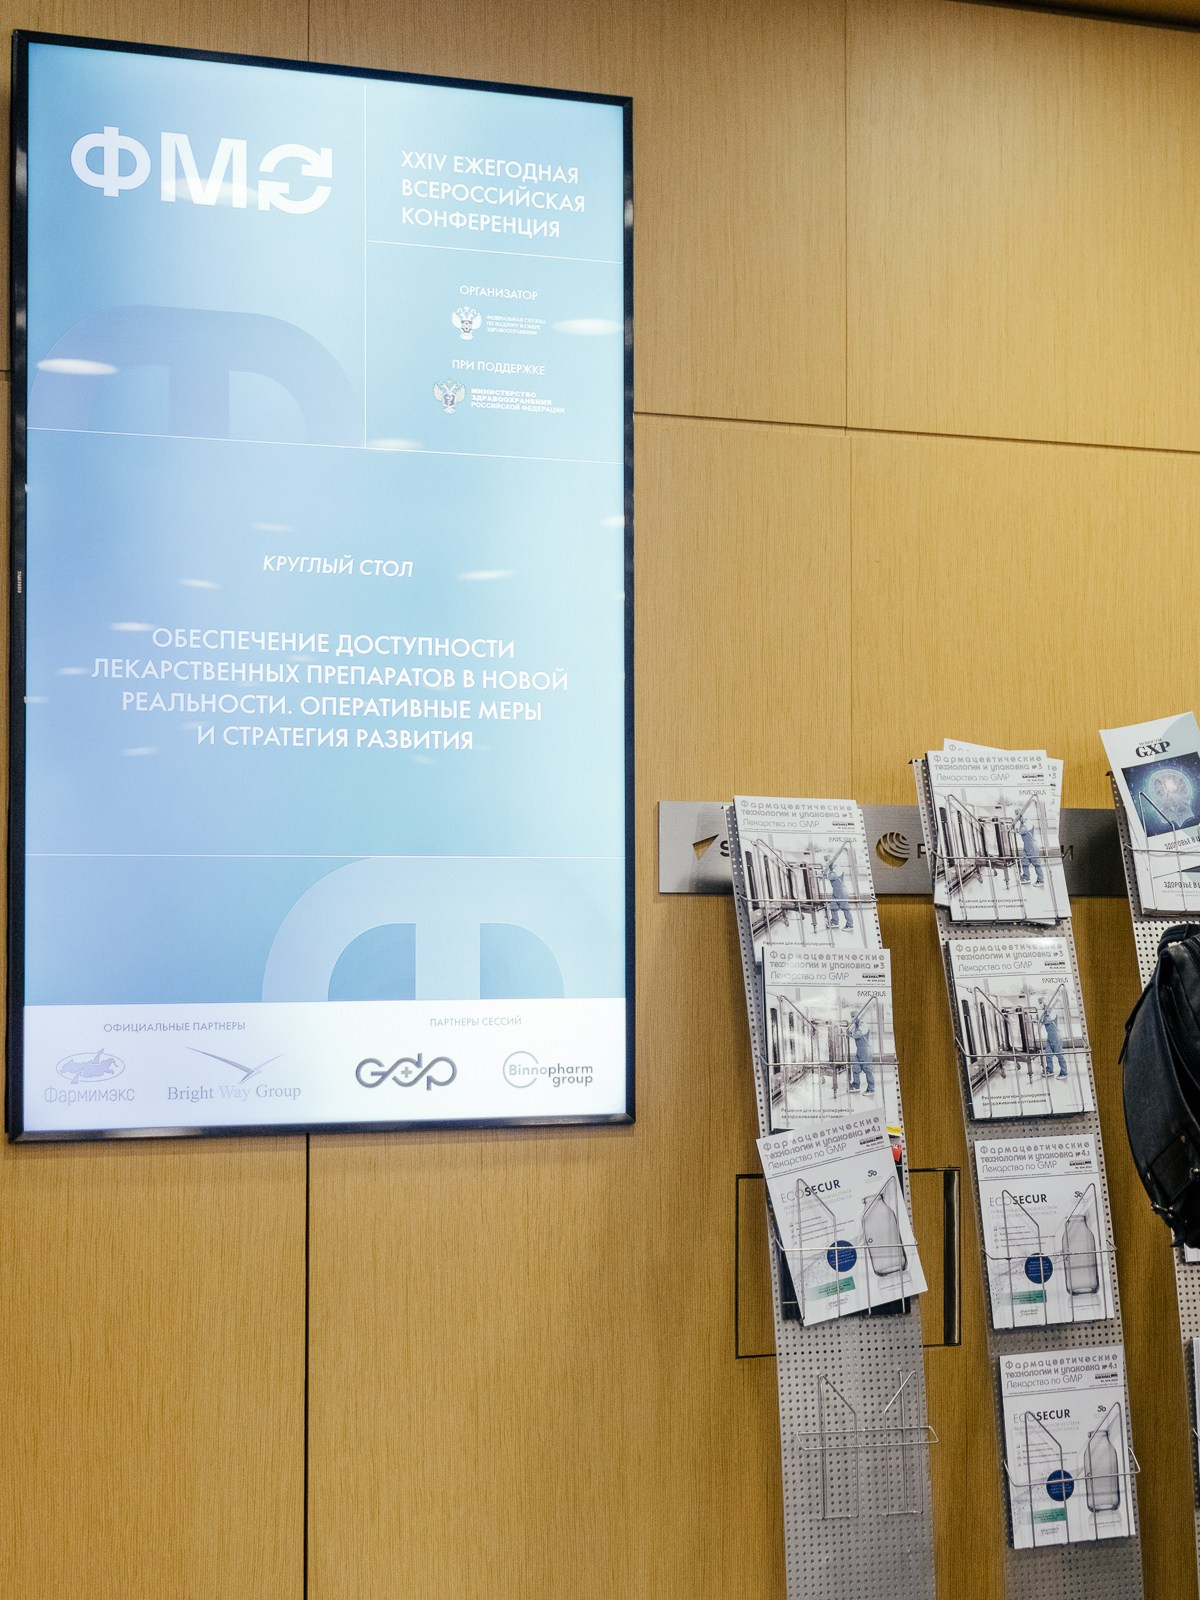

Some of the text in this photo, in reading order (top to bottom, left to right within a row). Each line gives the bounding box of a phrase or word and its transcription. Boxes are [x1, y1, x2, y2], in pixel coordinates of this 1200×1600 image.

[401, 149, 580, 185] XXIV ЕЖЕГОДНАЯ
[401, 177, 586, 213] ВСЕРОССИЙСКАЯ
[401, 206, 561, 239] КОНФЕРЕНЦИЯ
[459, 285, 538, 300] ОРГАНИЗАТОР
[452, 359, 546, 376] ПРИ ПОДДЕРЖКЕ
[471, 388, 537, 398] МИНИСТЕРСТВО
[263, 553, 414, 578] КРУГЛЫЙ СТОЛ
[151, 627, 516, 660] ОБЕСПЕЧЕНИЕ ДОСТУПНОСТИ
[91, 658, 569, 691] ЛЕКАРСТВЕННЫХ ПРЕПАРАТОВ В НОВОЙ
[122, 691, 542, 721] РЕАЛЬНОСТИ. ОПЕРАТИВНЫЕ МЕРЫ
[197, 725, 474, 750] И СТРАТЕГИЯ РАЗВИТИЯ
[1135, 741, 1171, 758] GXP
[990, 773, 1010, 781] GMP
[799, 820, 820, 828] GMP
[1013, 960, 1033, 969] GMP
[828, 972, 850, 980] GMP
[103, 1020, 246, 1034] ОФИЦИАЛЬНЫЕ ПАРТНЕРЫ
[430, 1014, 523, 1028] ПАРТНЕРЫ СЕССИЙ
[508, 1063, 594, 1079] Binnopharm
[552, 1074, 594, 1088] group
[44, 1086, 136, 1108] Фармимэкс
[167, 1083, 302, 1105] Bright Way Group
[825, 1143, 847, 1155] GMP
[1037, 1160, 1058, 1170] GMP
[1062, 1373, 1083, 1383] GMP
